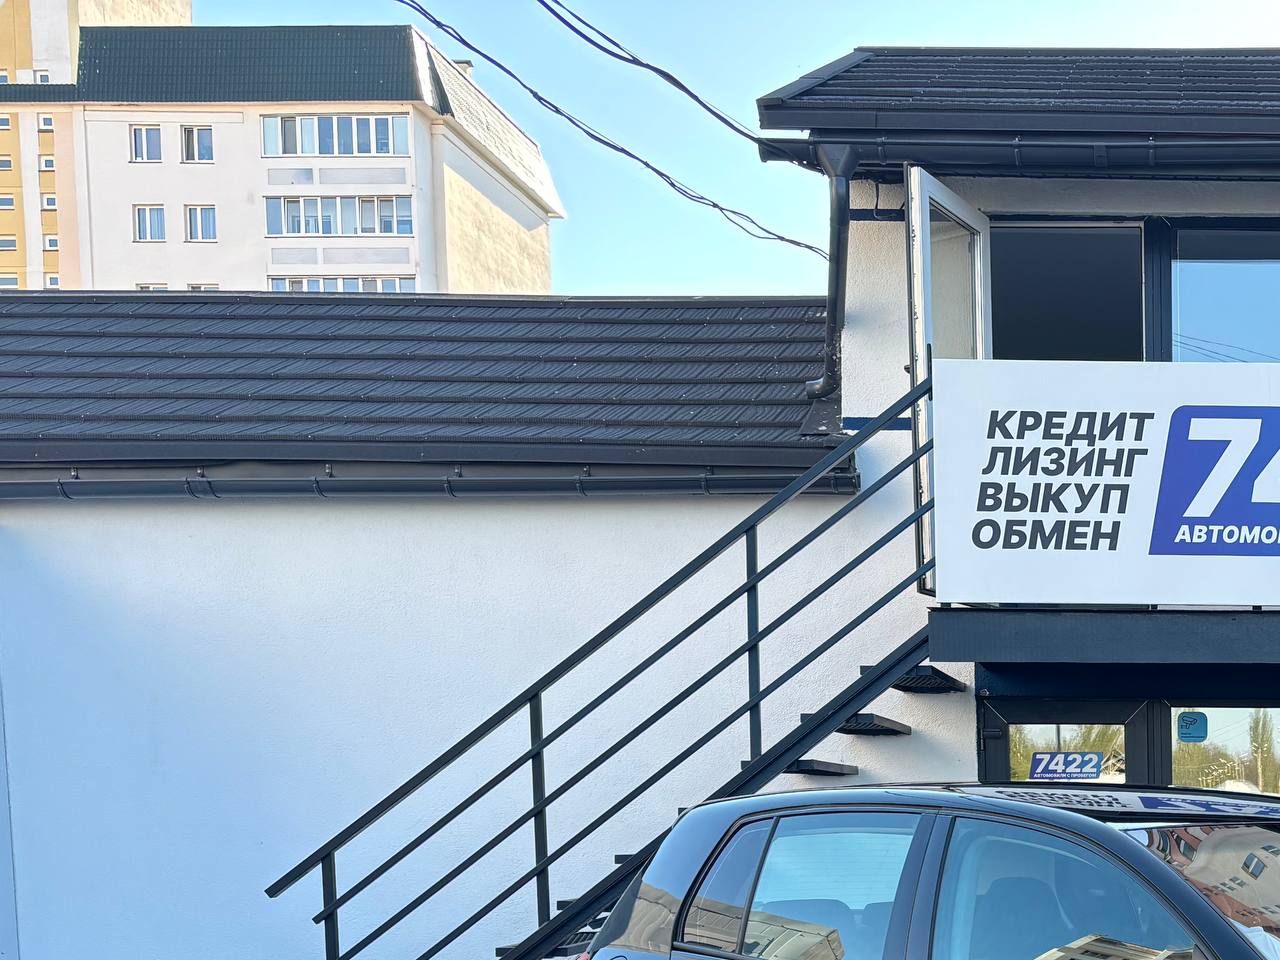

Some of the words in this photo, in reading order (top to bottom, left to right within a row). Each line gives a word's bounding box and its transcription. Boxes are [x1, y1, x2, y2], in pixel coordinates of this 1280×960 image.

[987, 410, 1155, 447] КРЕДИТ
[981, 446, 1149, 477] ЛИЗИНГ
[976, 481, 1130, 514] ВЫКУП
[971, 518, 1121, 551] ОБМЕН
[1035, 753, 1099, 773] 7422
